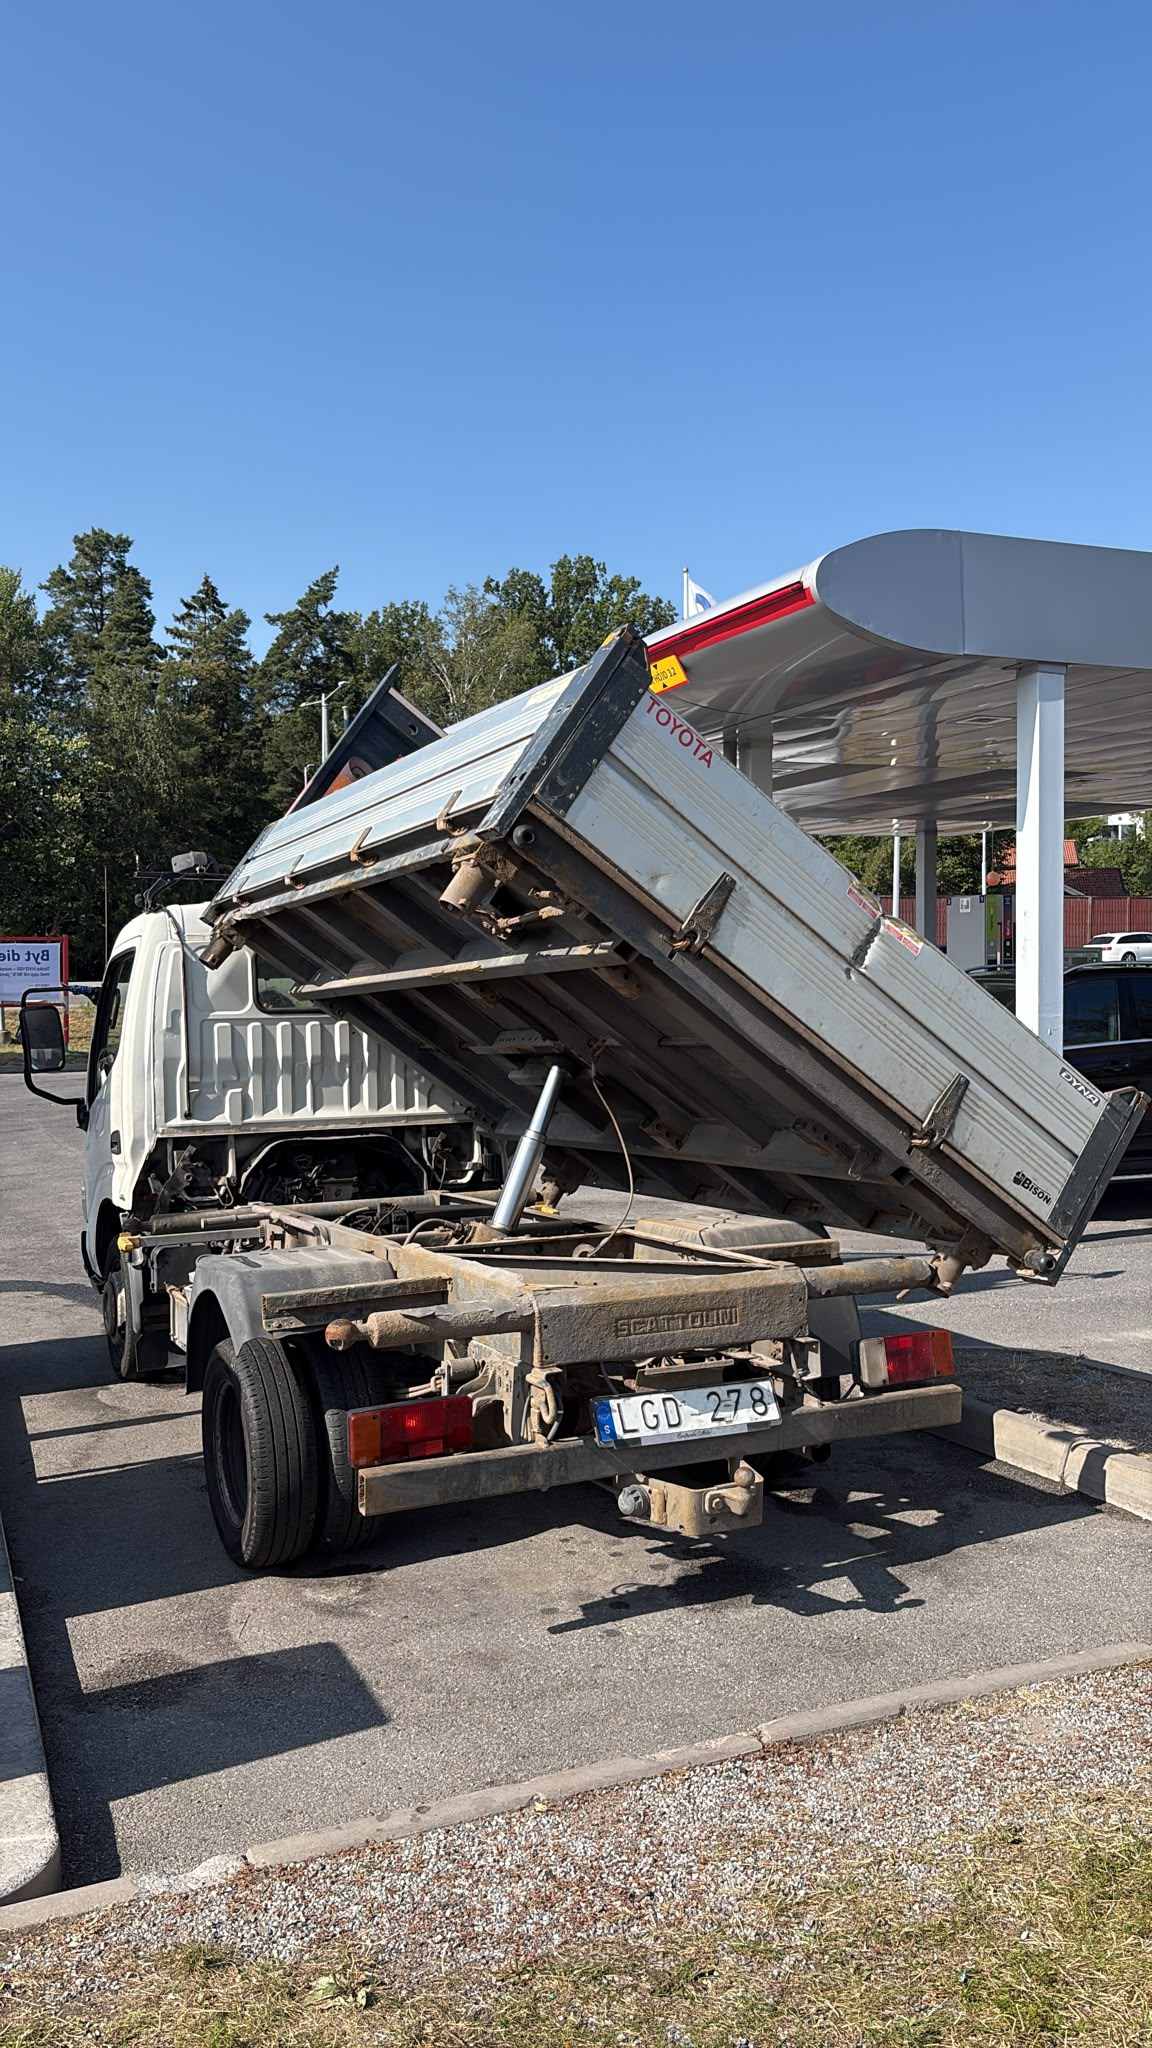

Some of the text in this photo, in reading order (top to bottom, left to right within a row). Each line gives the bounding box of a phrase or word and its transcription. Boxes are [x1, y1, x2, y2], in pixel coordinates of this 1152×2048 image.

[646, 696, 713, 768] TOYOTA
[1060, 1070, 1099, 1105] DYNA
[617, 1307, 738, 1337] SCATTOLINI
[616, 1386, 768, 1434] LGD 278
[604, 1425, 611, 1434] S
